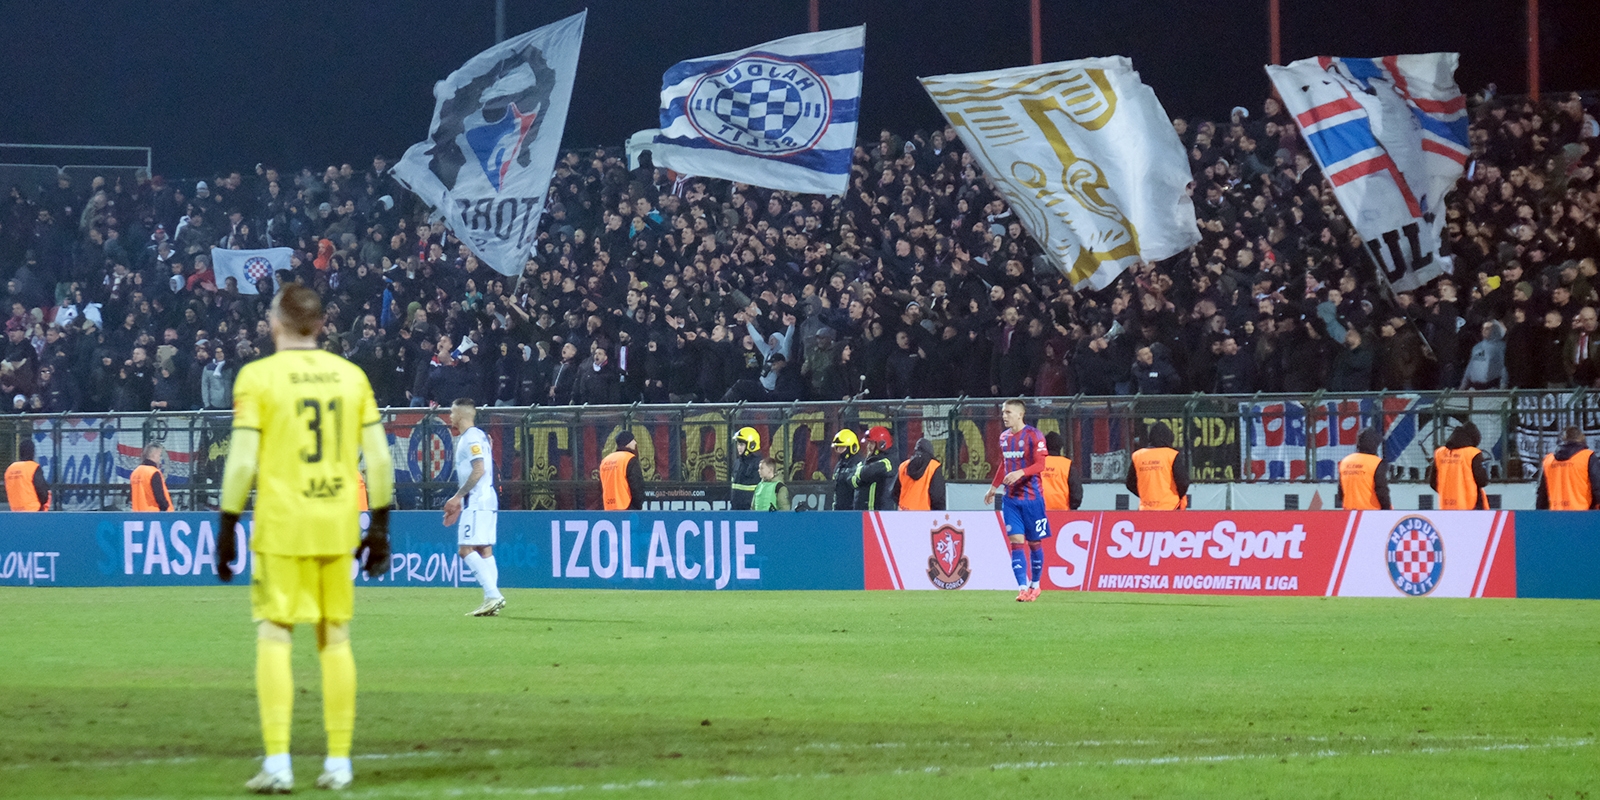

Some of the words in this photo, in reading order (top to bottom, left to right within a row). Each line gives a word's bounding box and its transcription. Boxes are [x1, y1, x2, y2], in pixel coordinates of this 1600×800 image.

[296, 395, 345, 464] 31
[464, 524, 471, 538] 2
[1035, 518, 1048, 533] 27
[1391, 519, 1439, 544] HAJDUK
[123, 520, 255, 576] FASAD
[551, 519, 760, 590] IZOLACIJE
[1106, 520, 1306, 566] SuperSport
[1098, 574, 1169, 589] HRVATSKA
[1172, 575, 1261, 590] NOGOMETNA
[1265, 576, 1299, 591] LIGA
[1396, 576, 1434, 595] SPLIT
